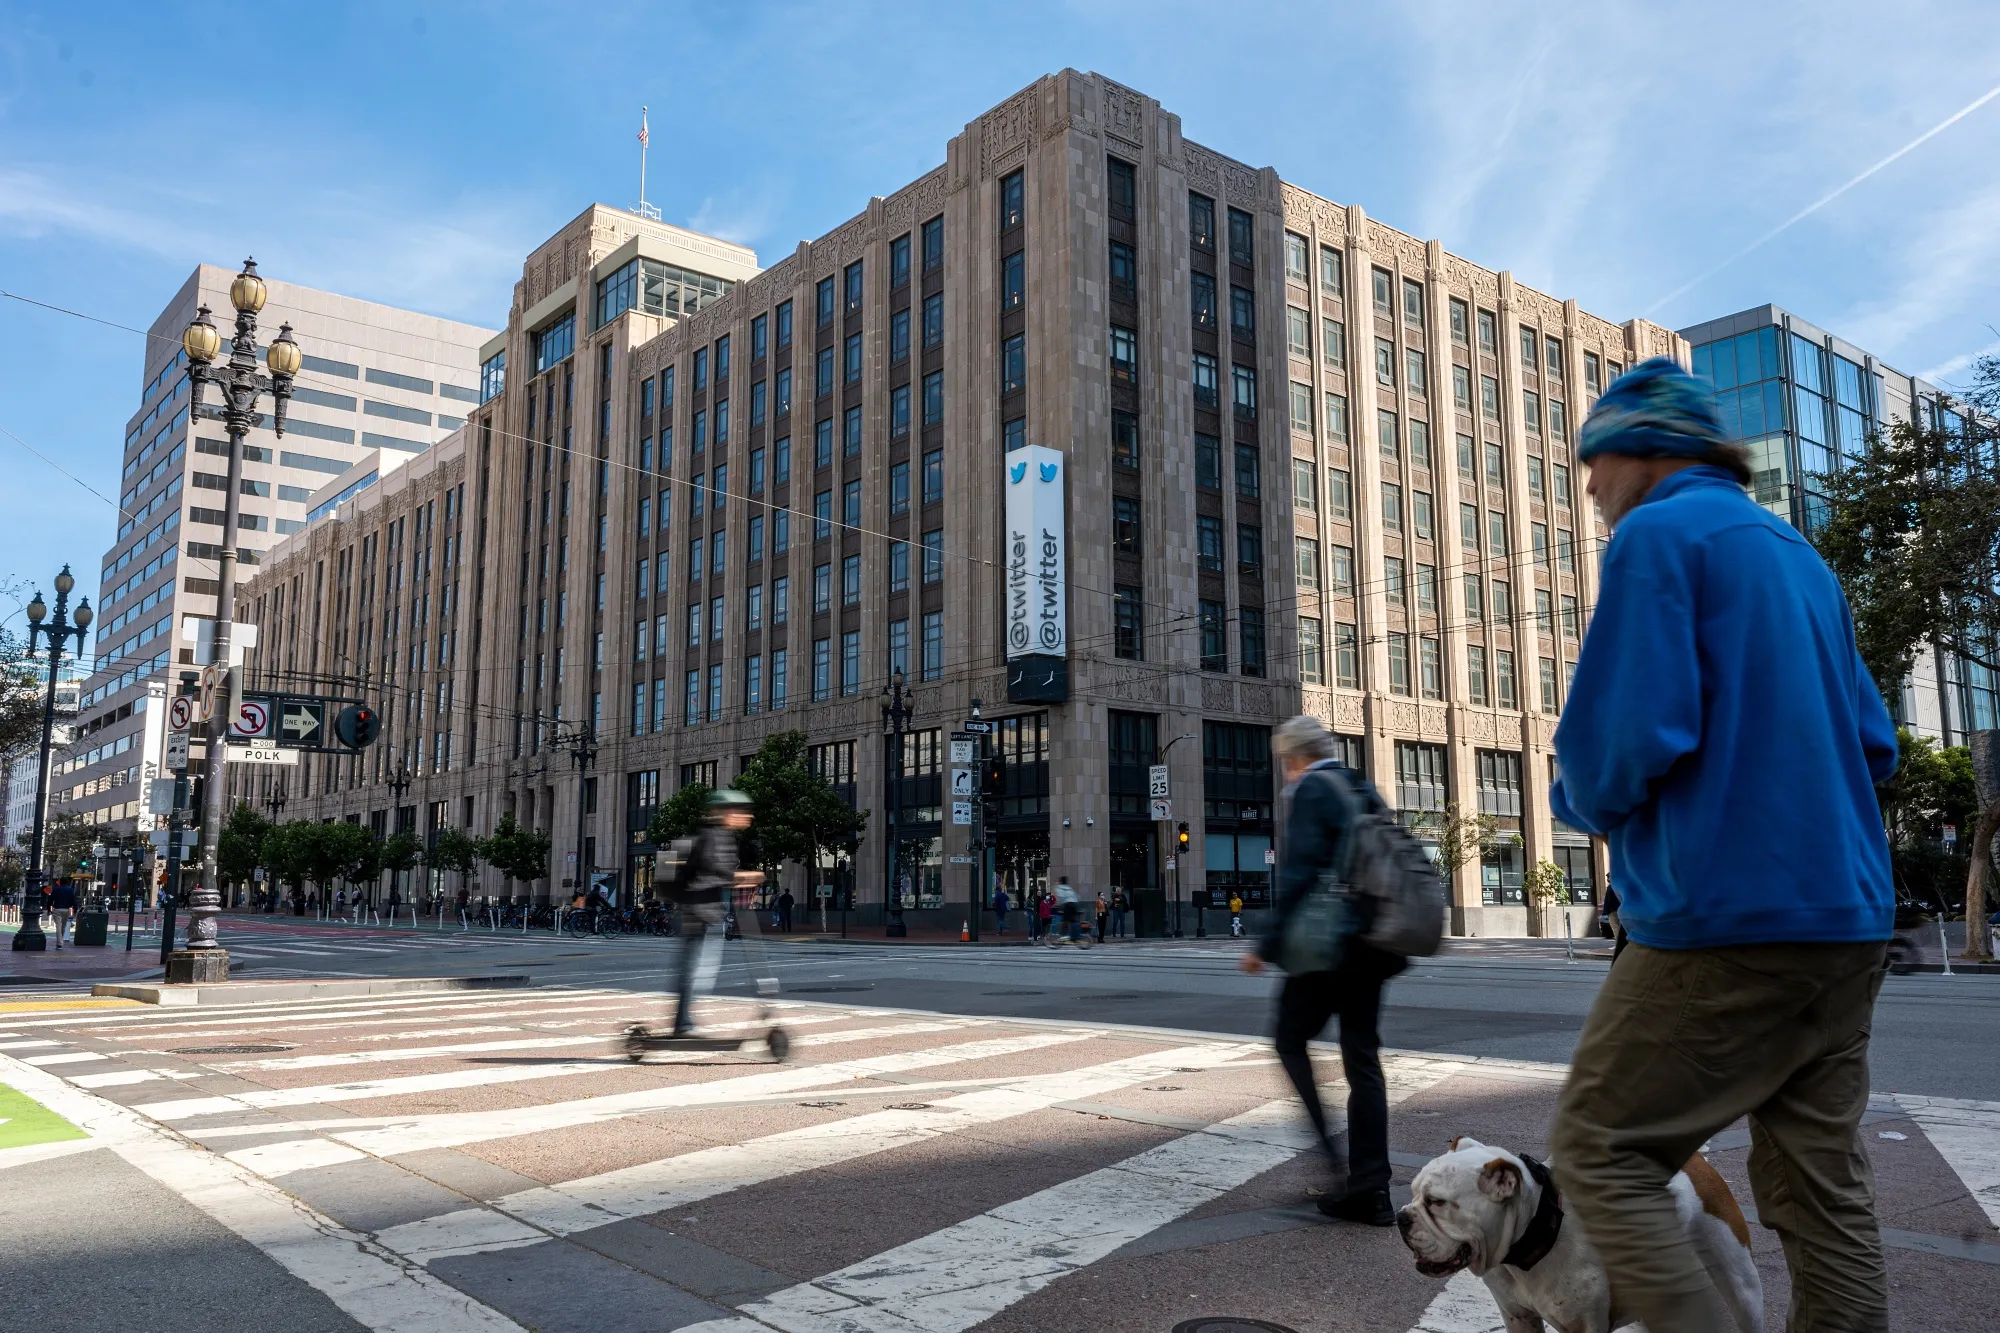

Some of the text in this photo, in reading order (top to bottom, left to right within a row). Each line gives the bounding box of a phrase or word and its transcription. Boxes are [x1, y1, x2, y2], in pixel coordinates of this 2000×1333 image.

[1010, 530, 1029, 649] @twitter
[1039, 528, 1061, 649] @twitter
[284, 718, 298, 726] ONE
[170, 736, 186, 744] EXCEPT
[245, 750, 280, 761] POLK
[1151, 782, 1167, 795] 25
